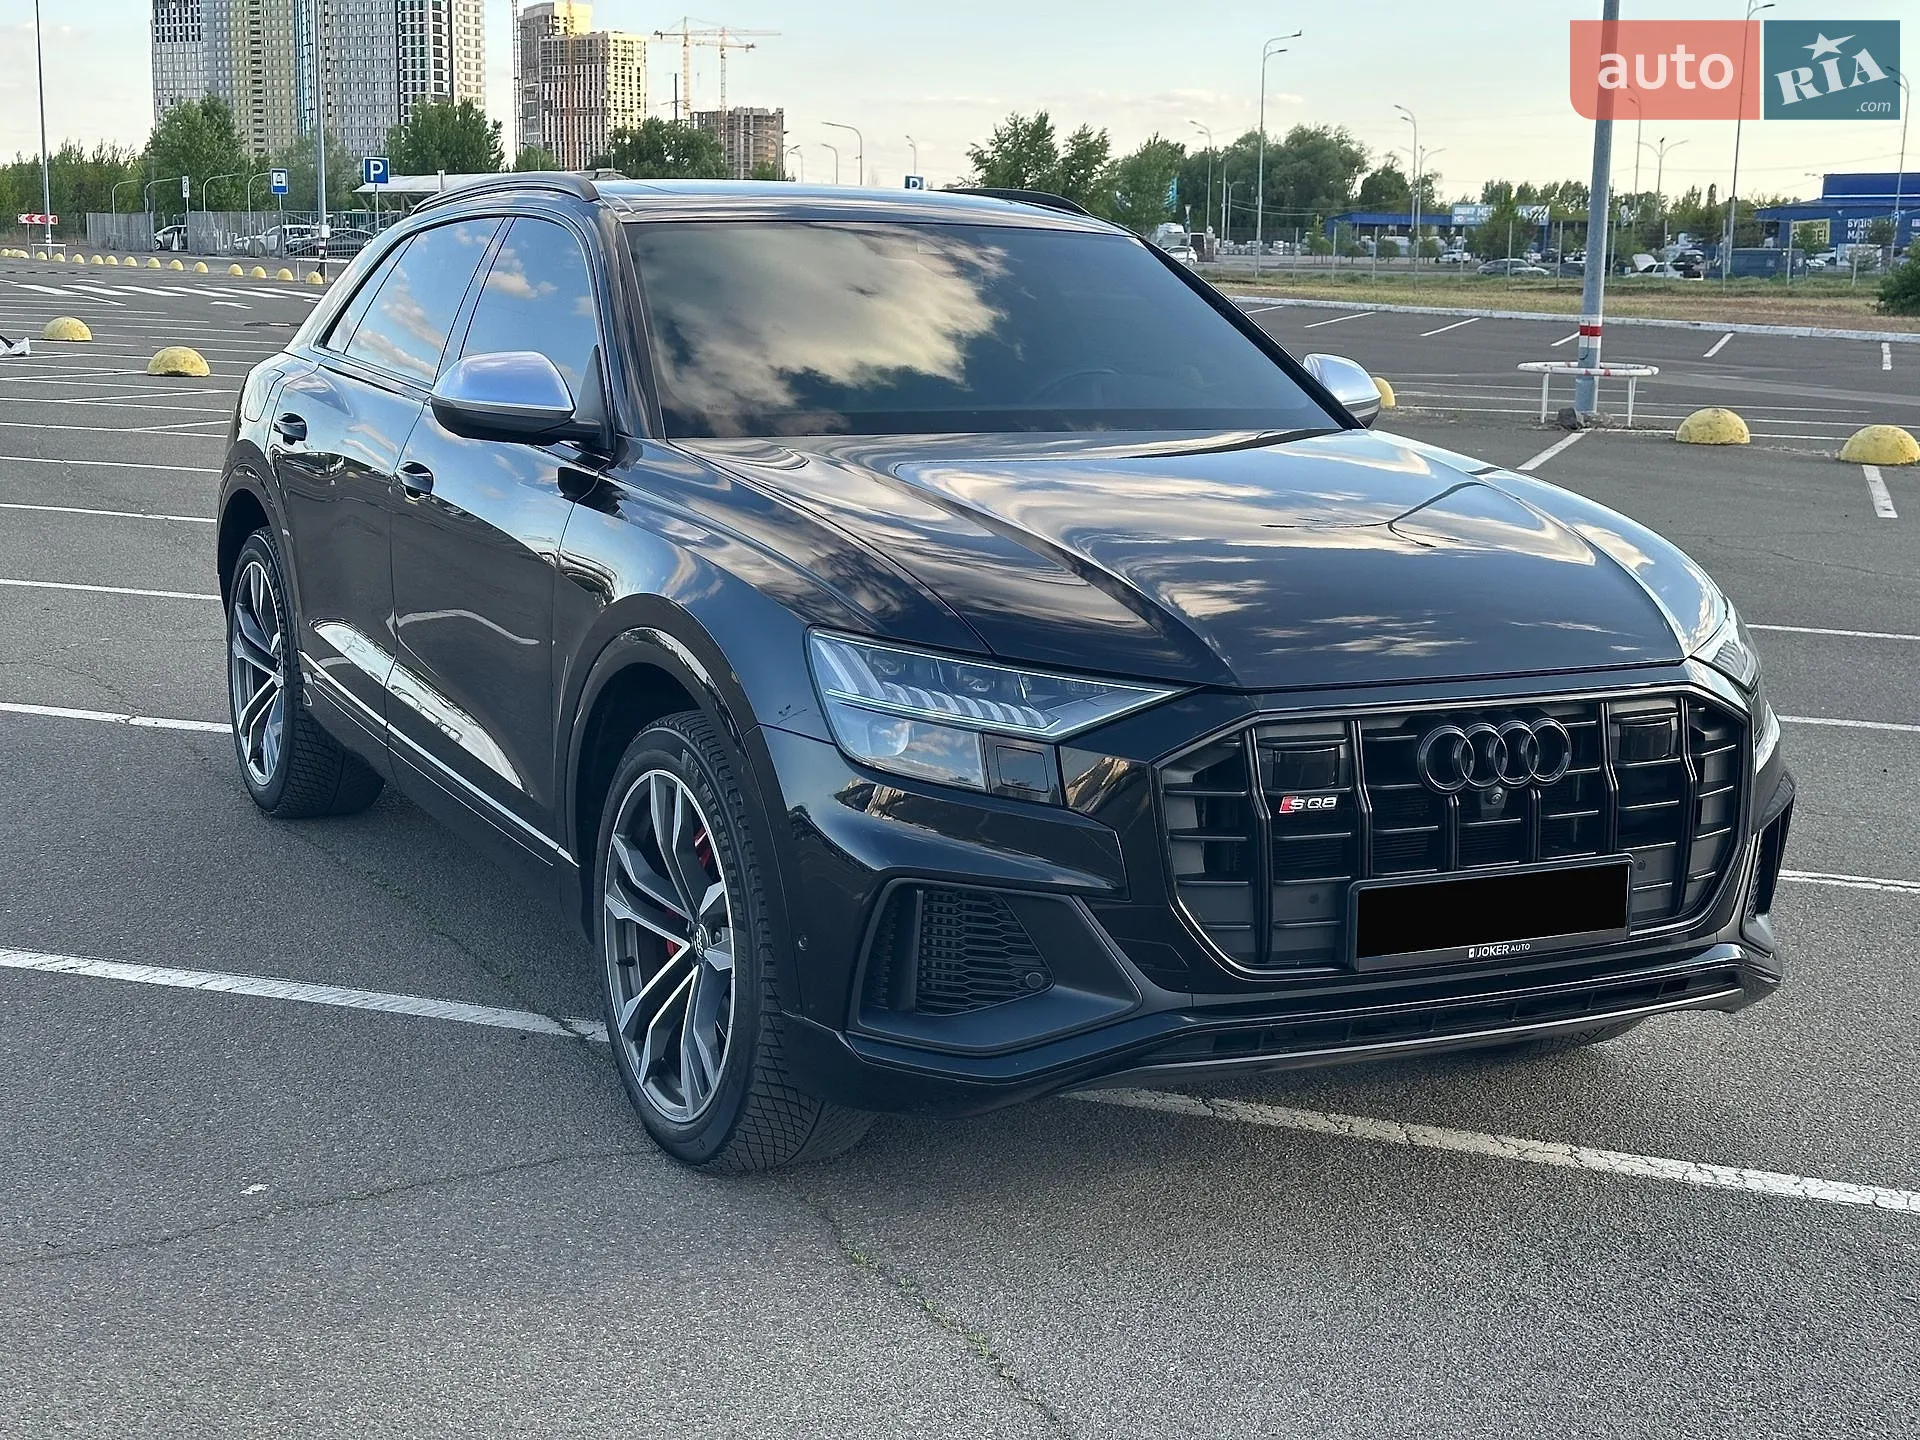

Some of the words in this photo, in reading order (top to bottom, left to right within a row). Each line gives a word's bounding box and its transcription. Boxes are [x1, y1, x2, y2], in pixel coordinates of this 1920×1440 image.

[370, 160, 384, 182] P
[1477, 944, 1509, 958] JOKER
[1510, 943, 1531, 952] AUTO
